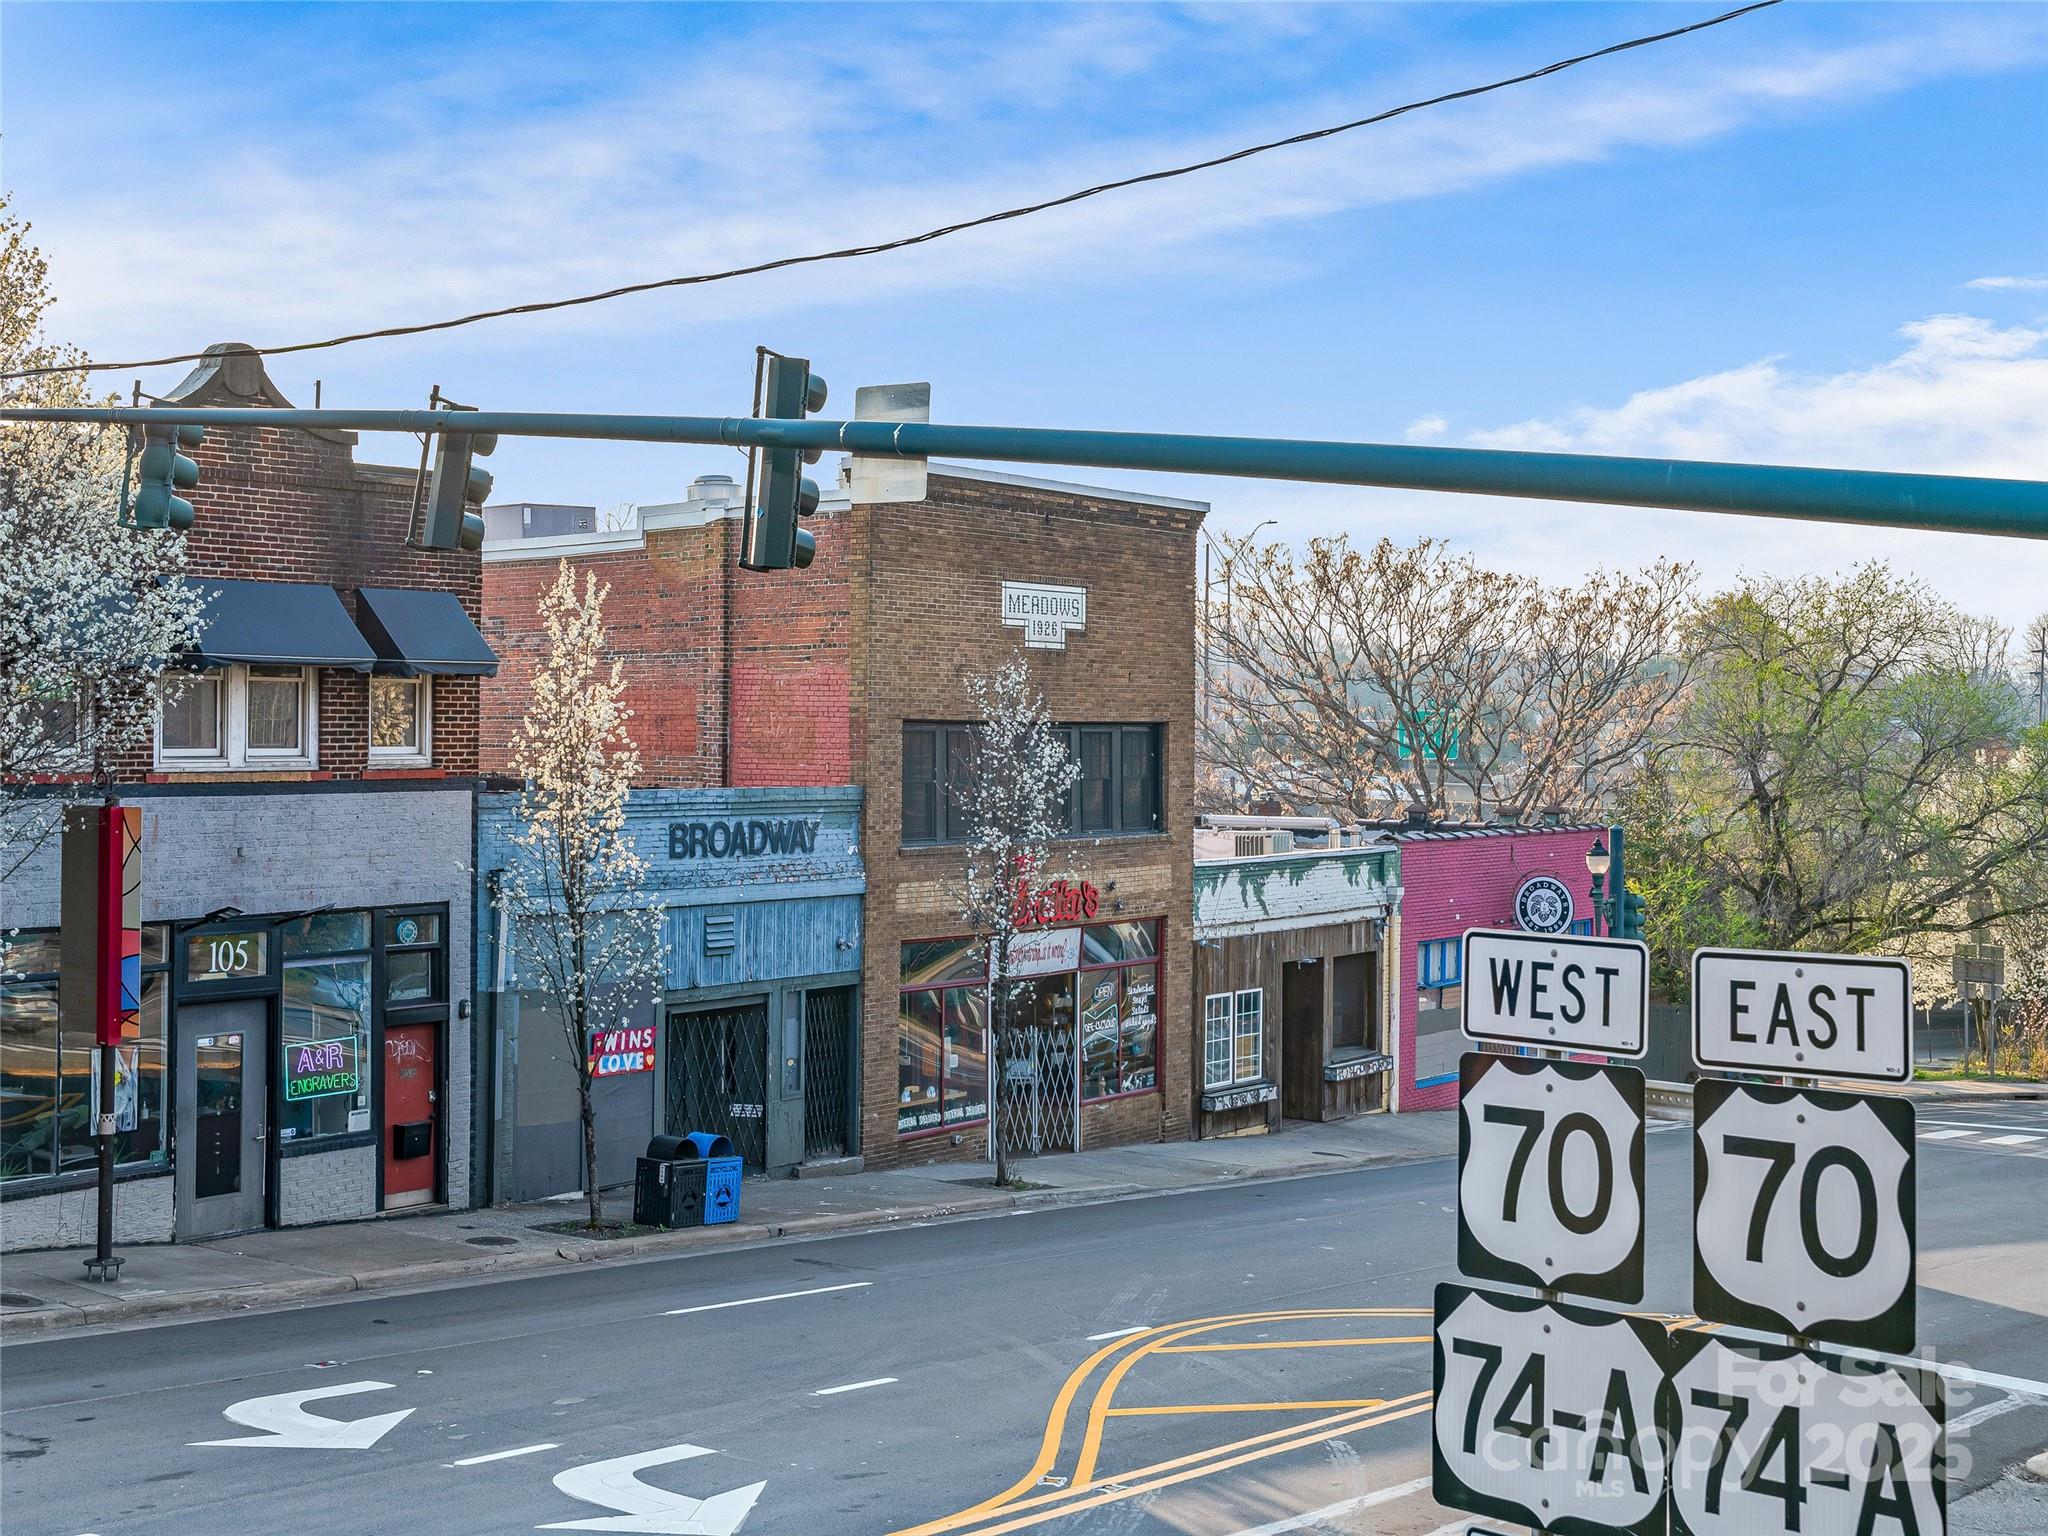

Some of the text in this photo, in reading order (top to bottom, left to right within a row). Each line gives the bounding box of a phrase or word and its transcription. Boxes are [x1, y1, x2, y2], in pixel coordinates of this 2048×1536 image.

[1009, 594, 1079, 617] MEADOWS
[1033, 620, 1057, 636] 1926
[669, 818, 820, 859] BROADWAY
[1521, 881, 1568, 907] BROADWAYS
[1524, 916, 1539, 931] EST
[208, 940, 248, 972] 105
[1094, 985, 1113, 998] OPEN
[1489, 957, 1620, 1027] WEST
[1729, 979, 1875, 1052] EAST
[605, 1029, 652, 1052] WINS
[297, 1042, 343, 1073] A&R
[598, 1052, 644, 1074] LOVE
[290, 1073, 355, 1096] ENGRAVERS
[1484, 1104, 1613, 1235] 70
[1723, 1134, 1878, 1278] 70
[1452, 1337, 1650, 1495] 74-A
[1691, 1387, 1921, 1536] 74-A
